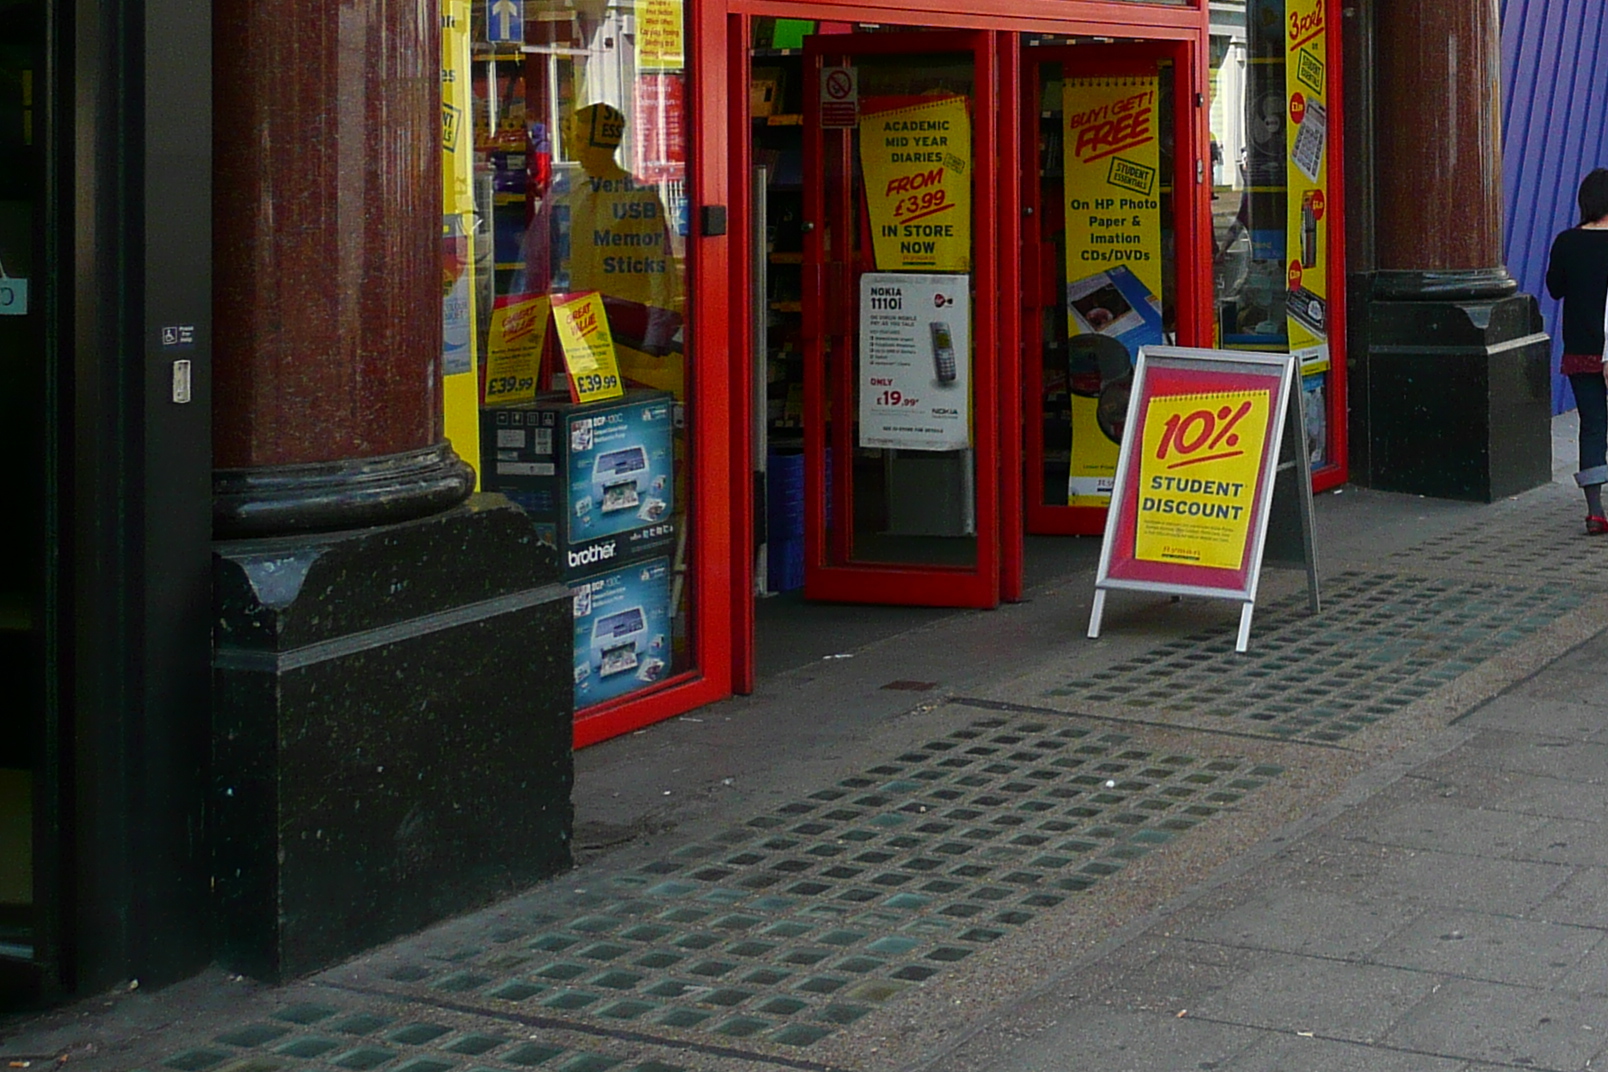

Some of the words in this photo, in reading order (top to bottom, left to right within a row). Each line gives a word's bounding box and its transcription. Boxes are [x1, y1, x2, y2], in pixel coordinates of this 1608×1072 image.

[883, 120, 950, 132] ACADEMIC
[1074, 107, 1152, 158] FREE
[885, 136, 909, 147] MID
[912, 136, 948, 147] YEAR
[891, 151, 943, 163] DIARIES
[1115, 162, 1150, 180] STUDENT
[885, 167, 944, 197] FROM
[612, 202, 656, 220] USB
[1070, 199, 1090, 210] On
[1095, 199, 1114, 210] HP
[1120, 198, 1158, 210] Photo
[1088, 215, 1127, 229] Paper
[1131, 215, 1141, 227] &
[881, 225, 898, 238] IN
[903, 225, 954, 238] STORE
[1090, 232, 1141, 244] Imation
[900, 241, 935, 254] NOW
[1081, 249, 1151, 261] CDs/DVDs
[603, 256, 666, 274] Sticks
[870, 286, 903, 297] NOKIA
[486, 377, 534, 396] £39.99
[577, 374, 618, 394] £39.99
[870, 378, 893, 386] ONLY
[1155, 400, 1253, 460] 10%
[1150, 475, 1244, 498] STUDENT
[1141, 497, 1244, 521] DISCOUNT
[567, 542, 616, 568] brother
